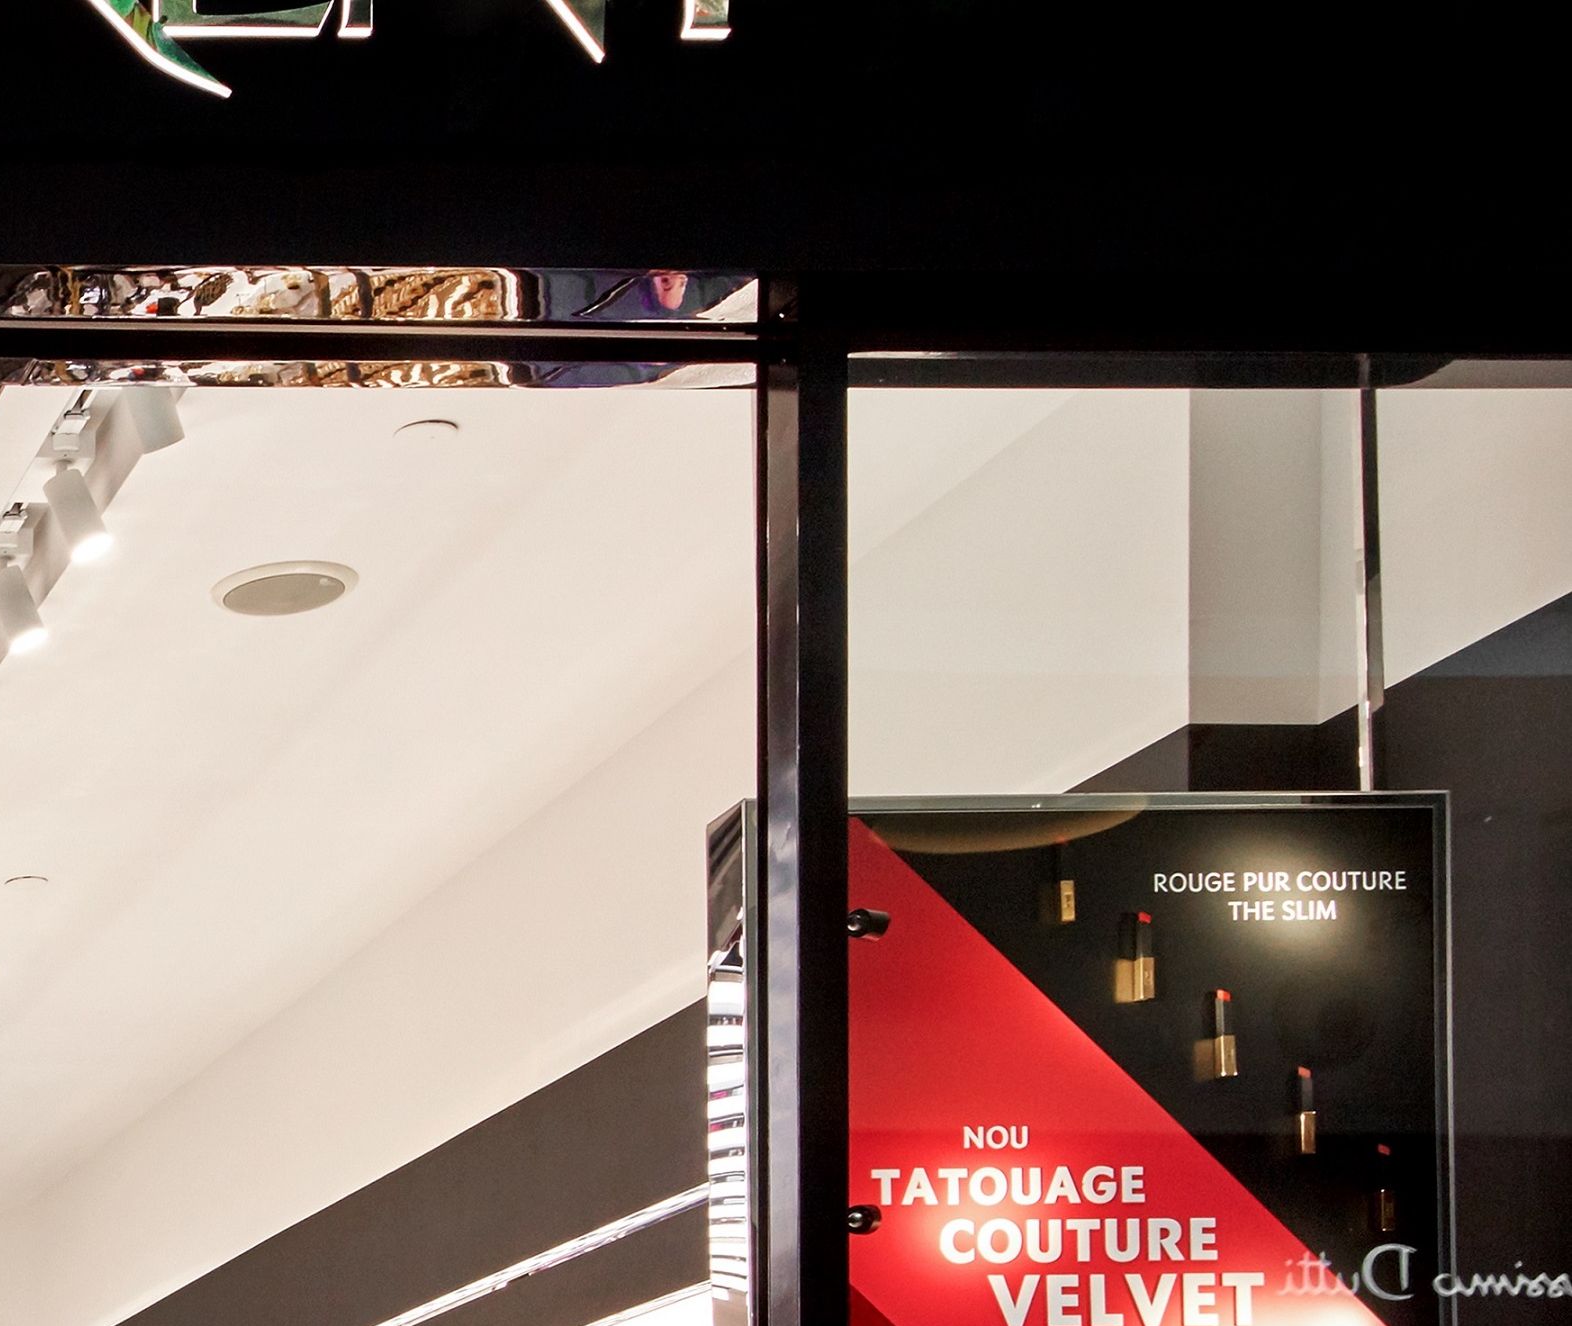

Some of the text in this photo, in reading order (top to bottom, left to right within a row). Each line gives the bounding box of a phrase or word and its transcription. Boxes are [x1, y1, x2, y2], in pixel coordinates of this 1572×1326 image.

[1153, 870, 1407, 893] ROUGE PUR COUTURE
[1228, 899, 1337, 921] THE SLIM
[962, 1125, 1030, 1150] NOU
[870, 1165, 1146, 1206] TATOUAGE
[938, 1216, 1218, 1264] COUTURE
